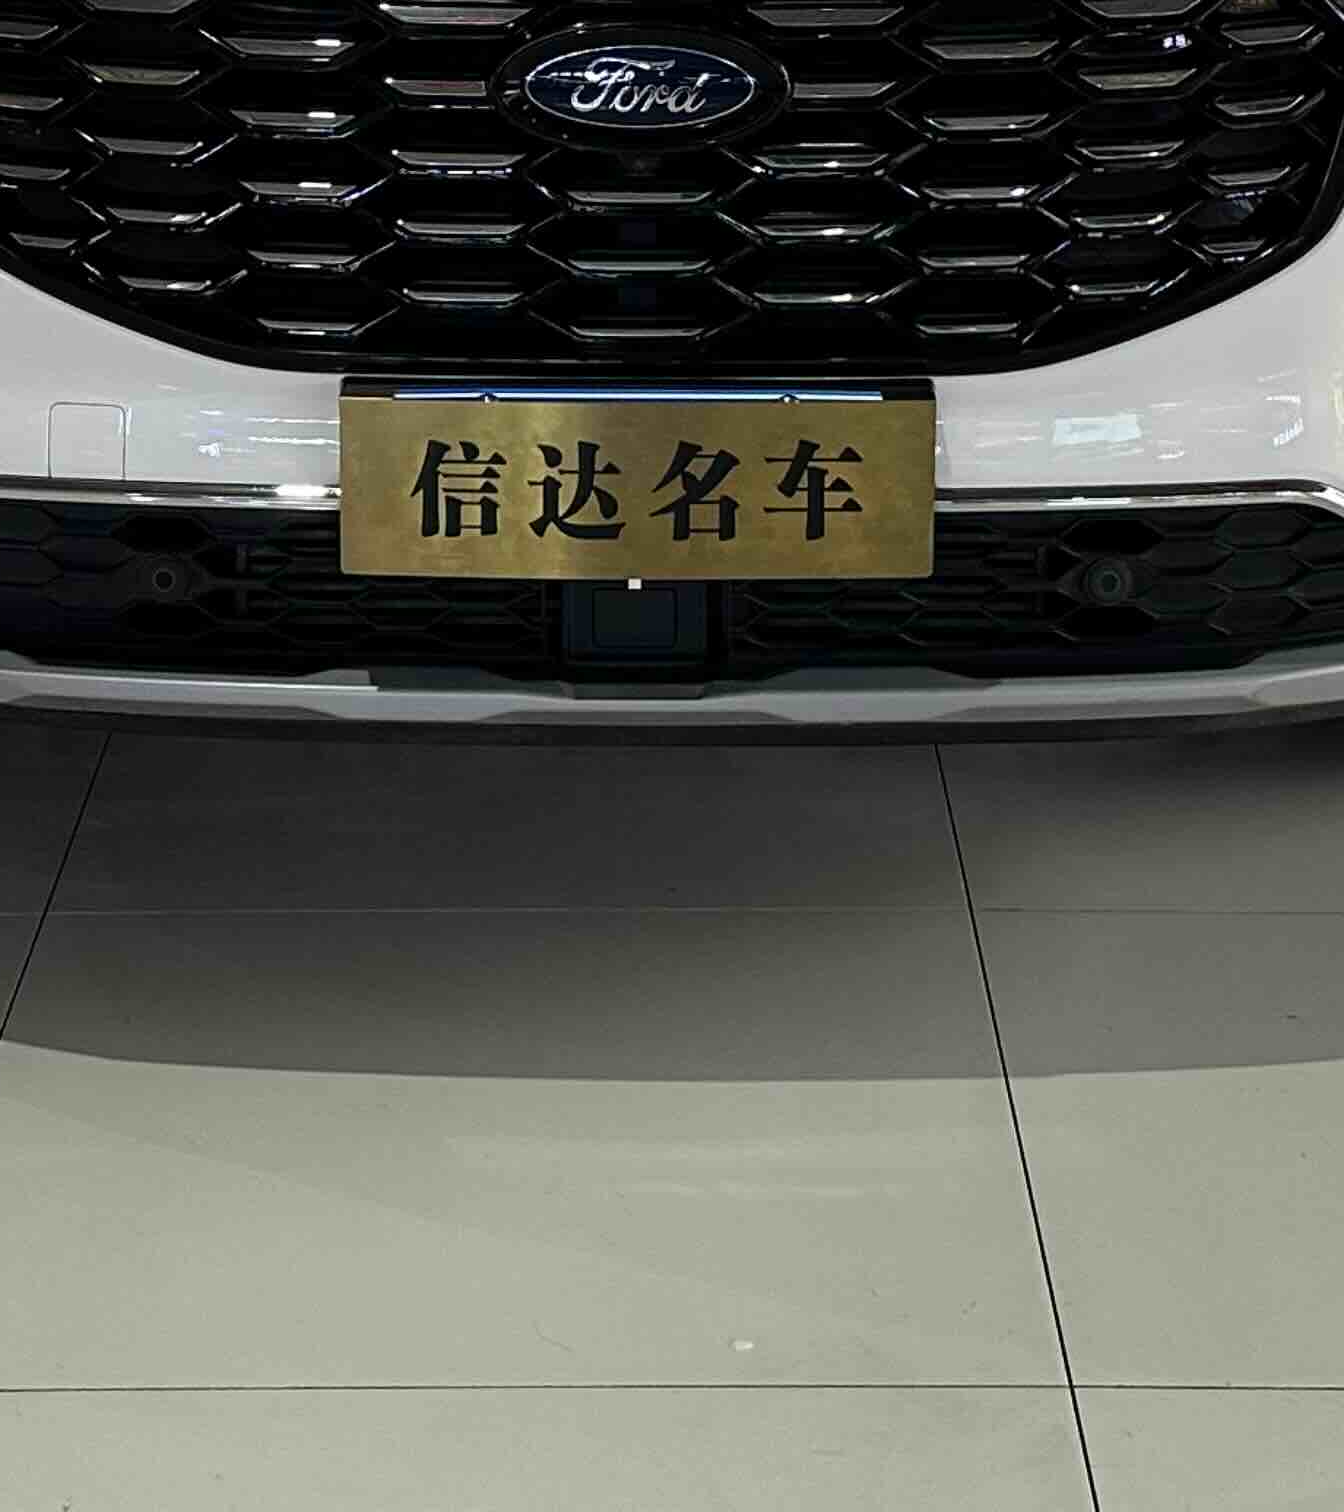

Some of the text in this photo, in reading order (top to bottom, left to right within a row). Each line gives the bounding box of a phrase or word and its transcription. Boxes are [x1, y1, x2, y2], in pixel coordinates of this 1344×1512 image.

[570, 54, 709, 115] Ford
[410, 439, 865, 542] 信达名车
